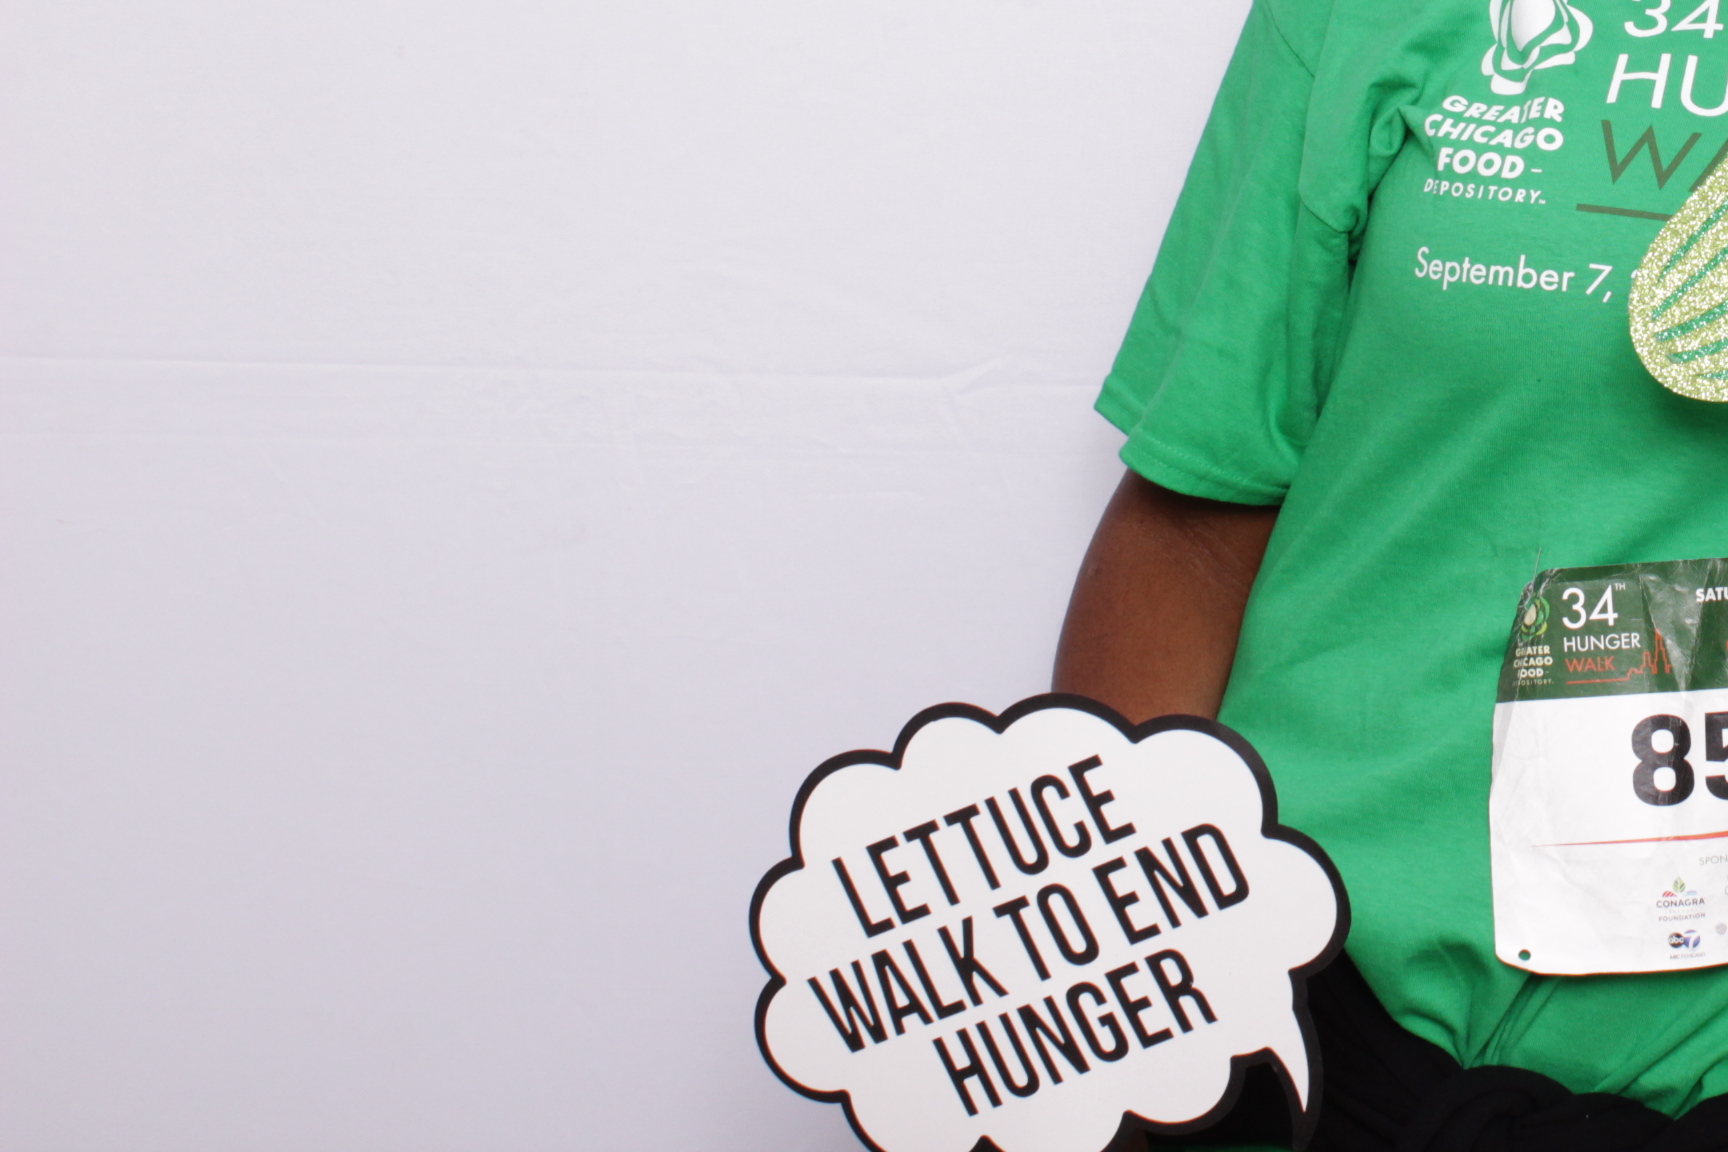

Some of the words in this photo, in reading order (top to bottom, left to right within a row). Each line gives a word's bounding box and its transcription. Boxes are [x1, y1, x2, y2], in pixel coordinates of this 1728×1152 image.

[1442, 95, 1565, 124] GREATER
[1424, 114, 1564, 151] CHICAGO
[1414, 246, 1575, 292] September
[1585, 263, 1614, 304] 7,
[1563, 632, 1642, 653] HUNGER
[1564, 655, 1617, 673] WALK
[832, 754, 1137, 938] LETTUCE
[1656, 896, 1706, 909] CONAGRA
[1658, 911, 1706, 923] FOUNDATION
[807, 916, 1009, 1053] WALK
[993, 883, 1100, 981] TO
[1092, 823, 1250, 946] END
[932, 948, 1219, 1117] HUNGER
